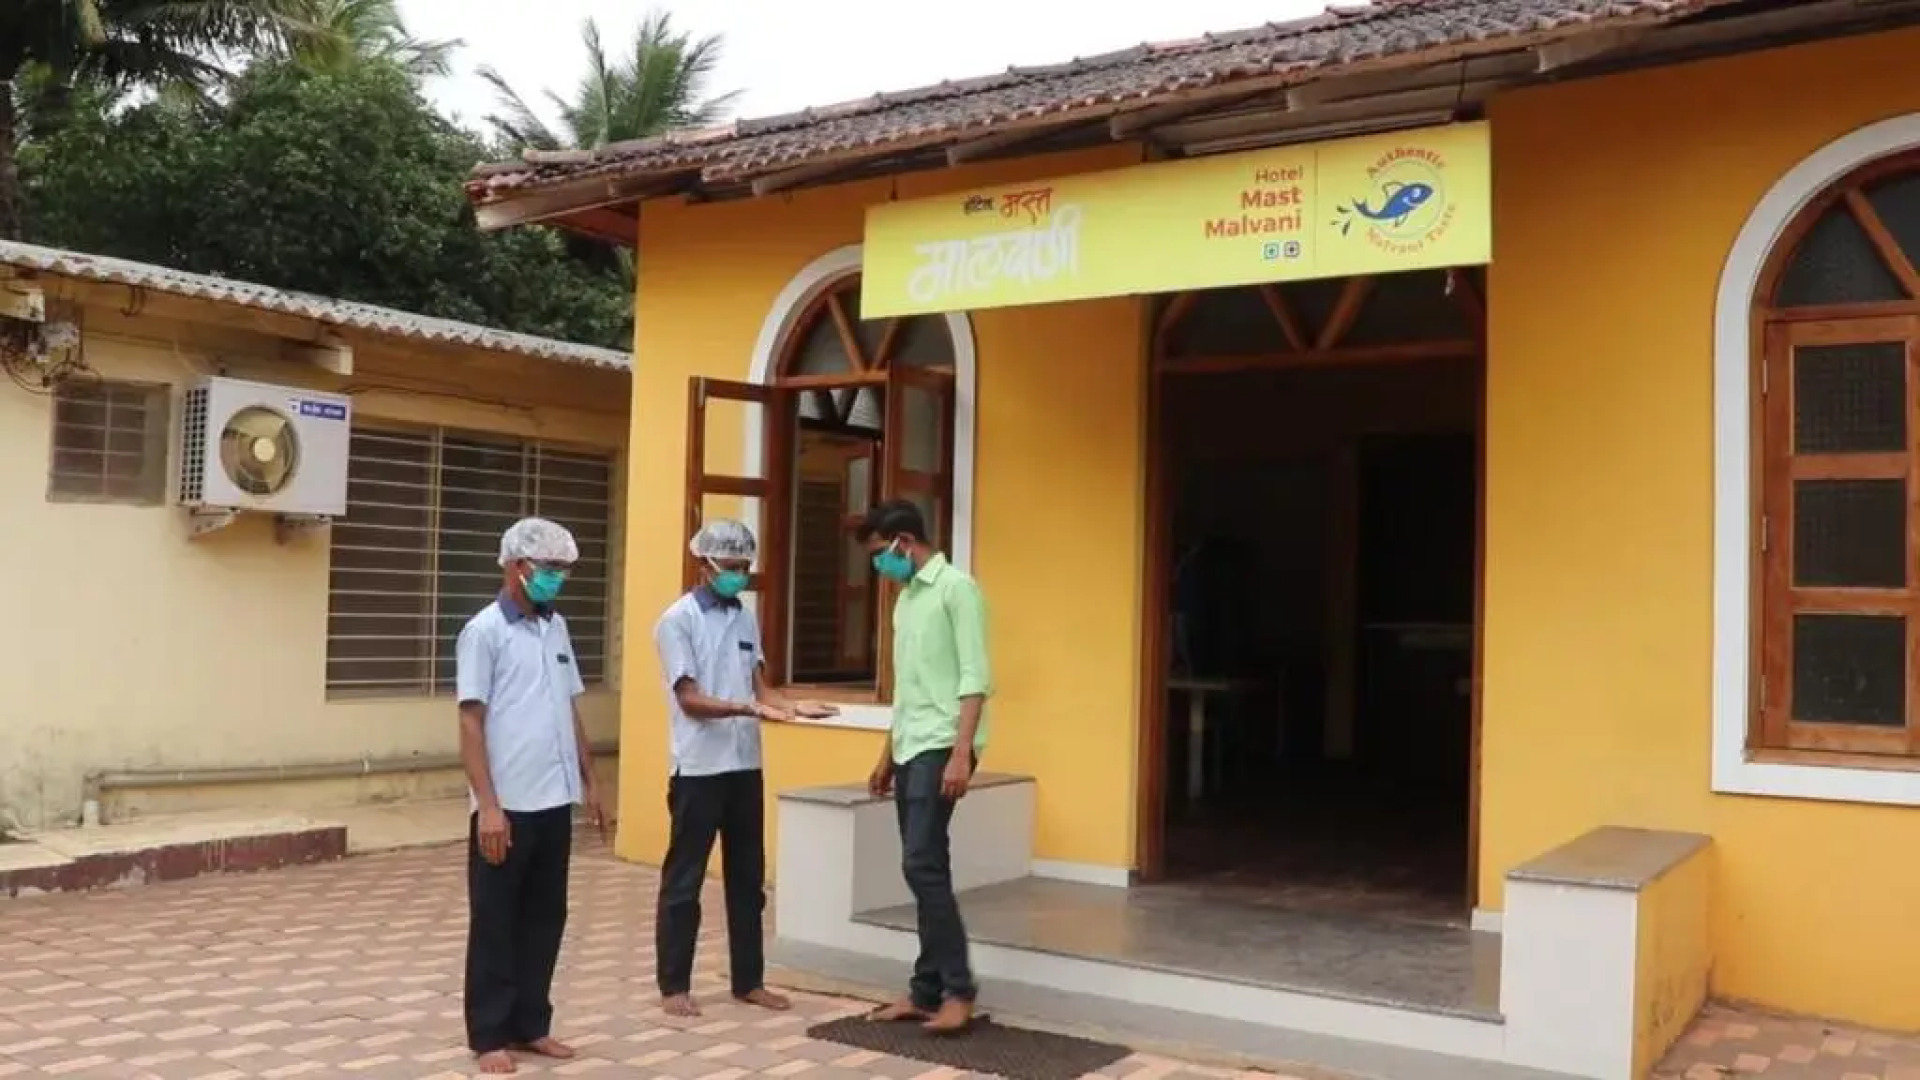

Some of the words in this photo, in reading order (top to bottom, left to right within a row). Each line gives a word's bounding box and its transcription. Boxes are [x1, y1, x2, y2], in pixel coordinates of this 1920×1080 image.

[1255, 166, 1303, 182] Hotel
[1366, 148, 1445, 179] Authentic
[1001, 188, 1054, 224] मस्त
[1242, 187, 1302, 210] Mast
[1205, 209, 1301, 238] Malvani
